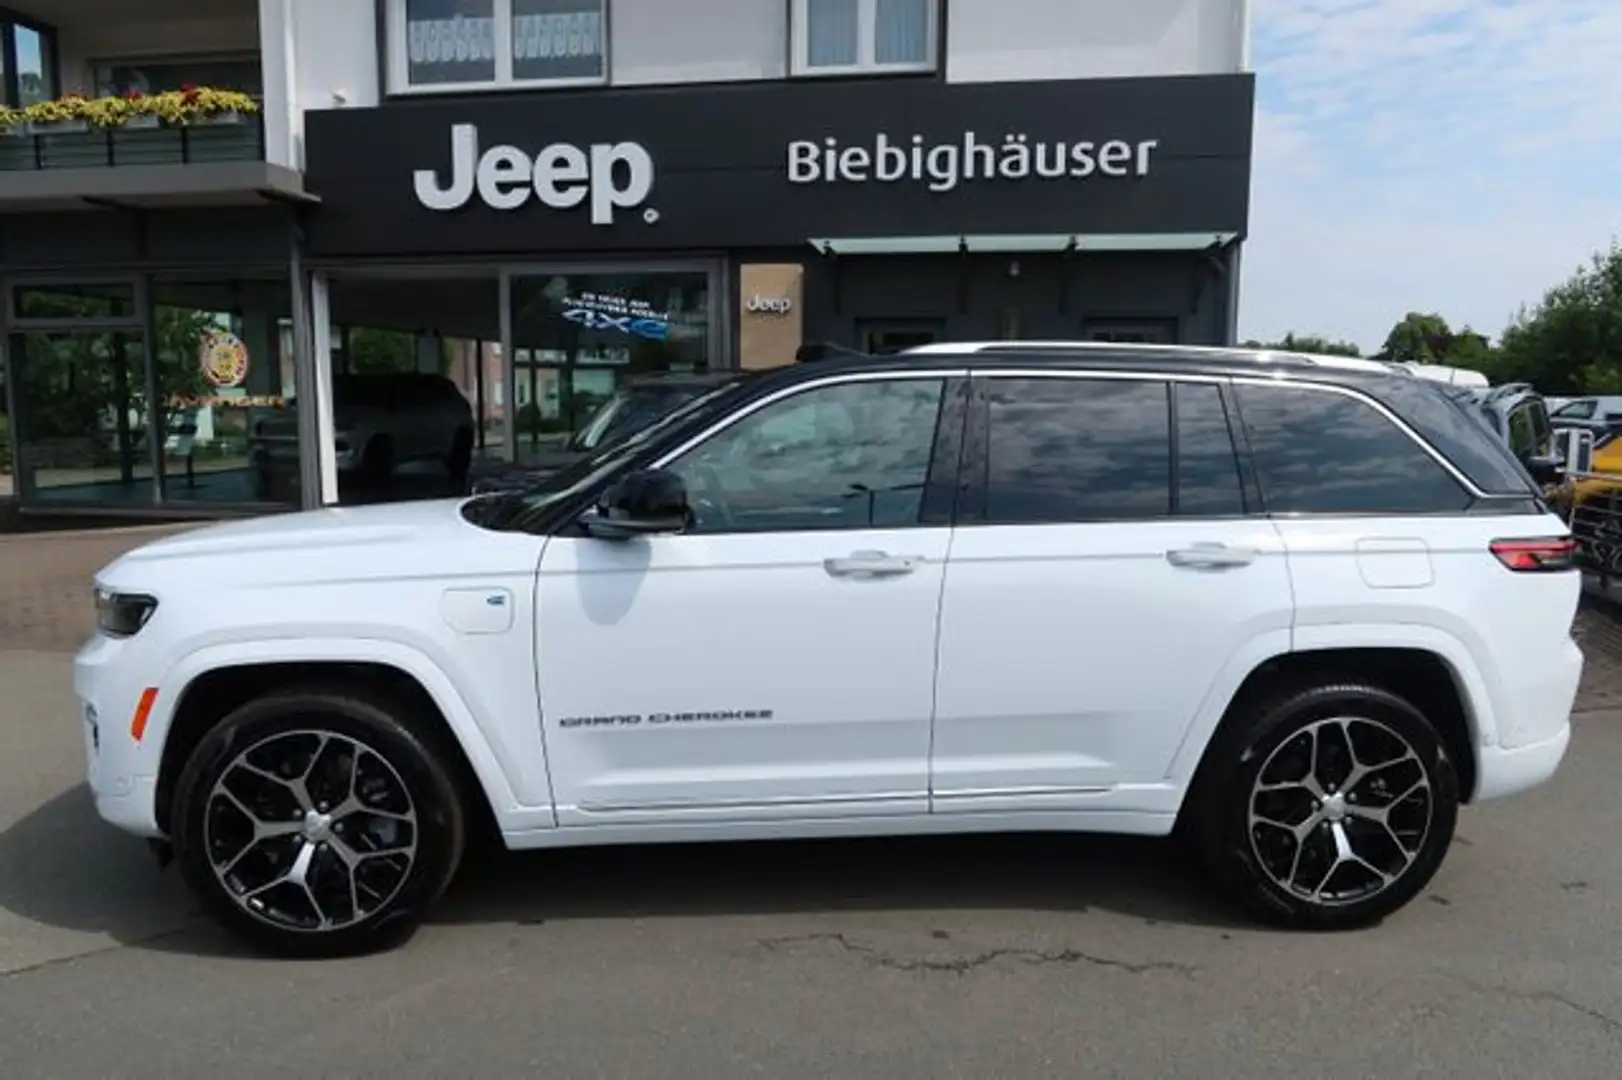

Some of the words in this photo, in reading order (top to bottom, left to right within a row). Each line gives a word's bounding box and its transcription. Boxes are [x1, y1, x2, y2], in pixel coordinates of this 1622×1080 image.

[413, 123, 654, 224] Jeep
[787, 131, 1158, 192] Biebighäuser
[559, 714, 642, 728] GRAND
[648, 709, 774, 723] CHEROKEE
